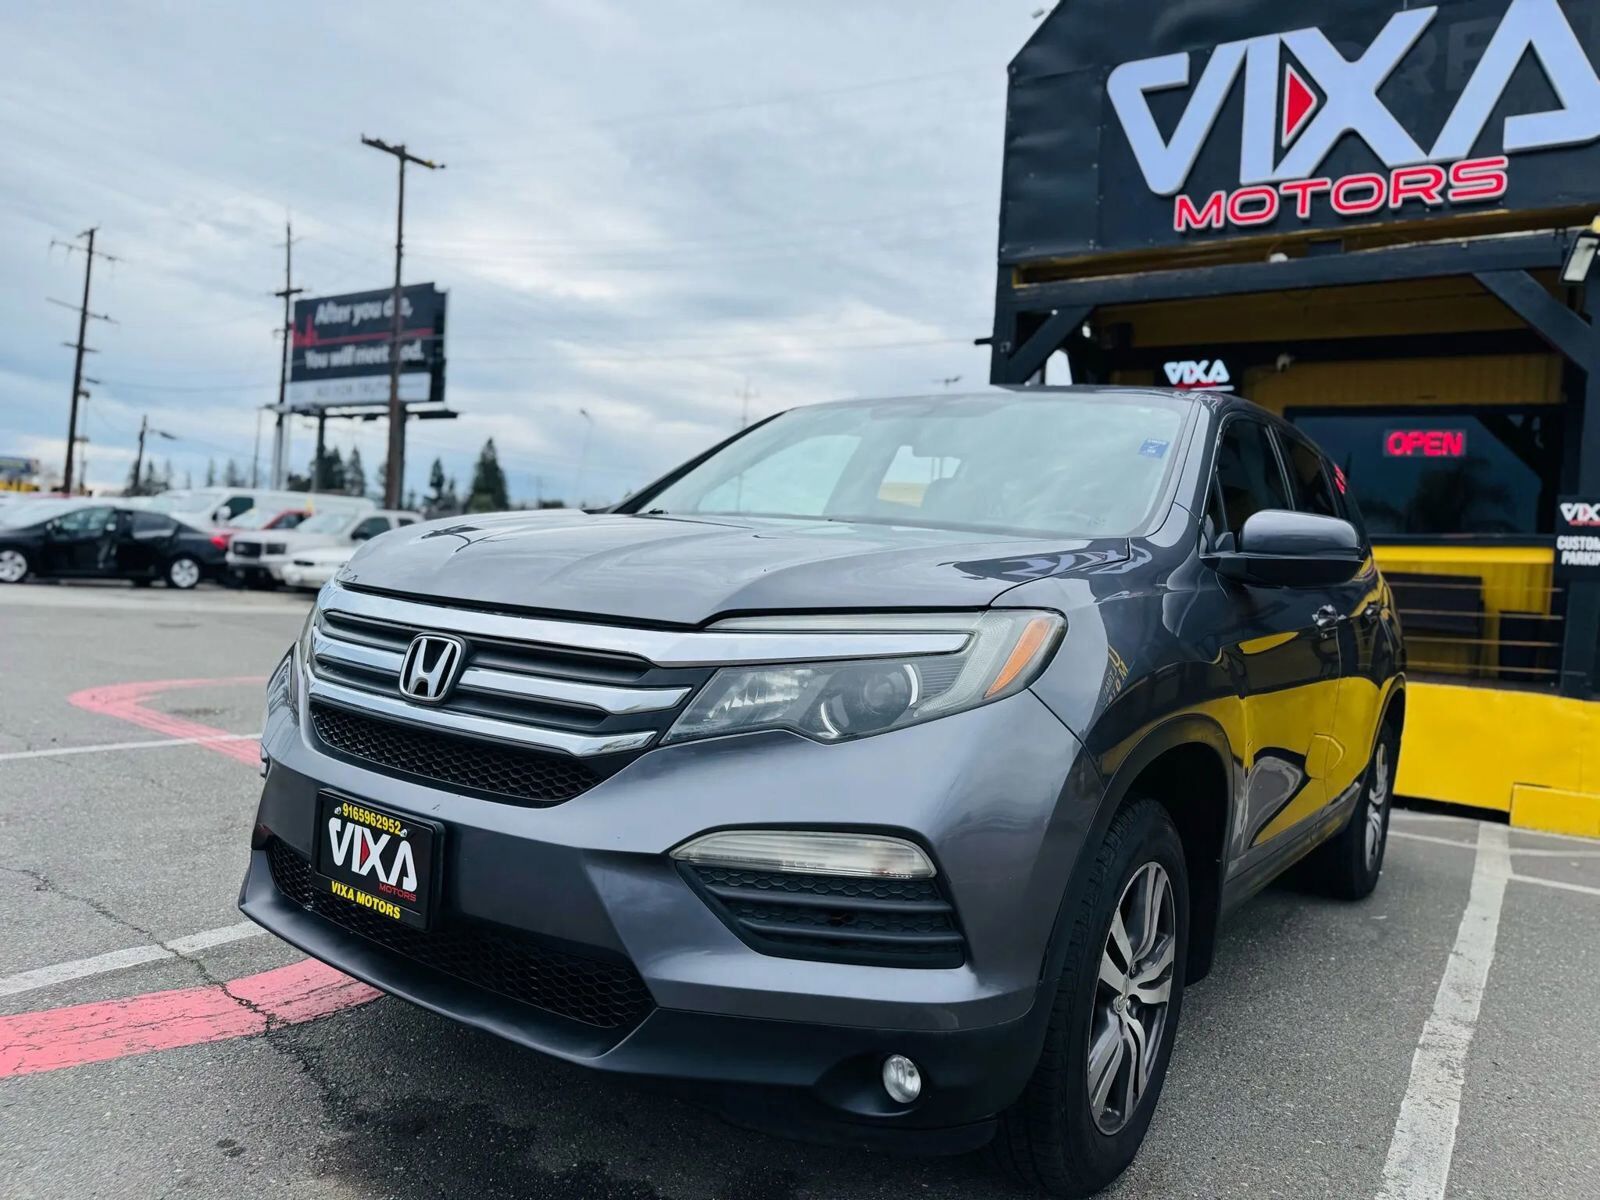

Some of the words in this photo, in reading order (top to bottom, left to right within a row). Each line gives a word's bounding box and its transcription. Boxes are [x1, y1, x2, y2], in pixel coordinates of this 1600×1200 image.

[1106, 0, 1600, 195] VIXA
[1174, 155, 1509, 232] MOTORS
[352, 301, 383, 326] you
[383, 294, 413, 319] de,
[304, 349, 328, 369] You
[1163, 358, 1230, 385] VIXA
[1386, 431, 1464, 456] OPEN
[342, 802, 401, 836] 9165962952
[328, 817, 417, 892] VIXA
[331, 881, 355, 901] VIXA
[356, 891, 401, 919] MOTORS
[379, 883, 417, 902] MOTORS
